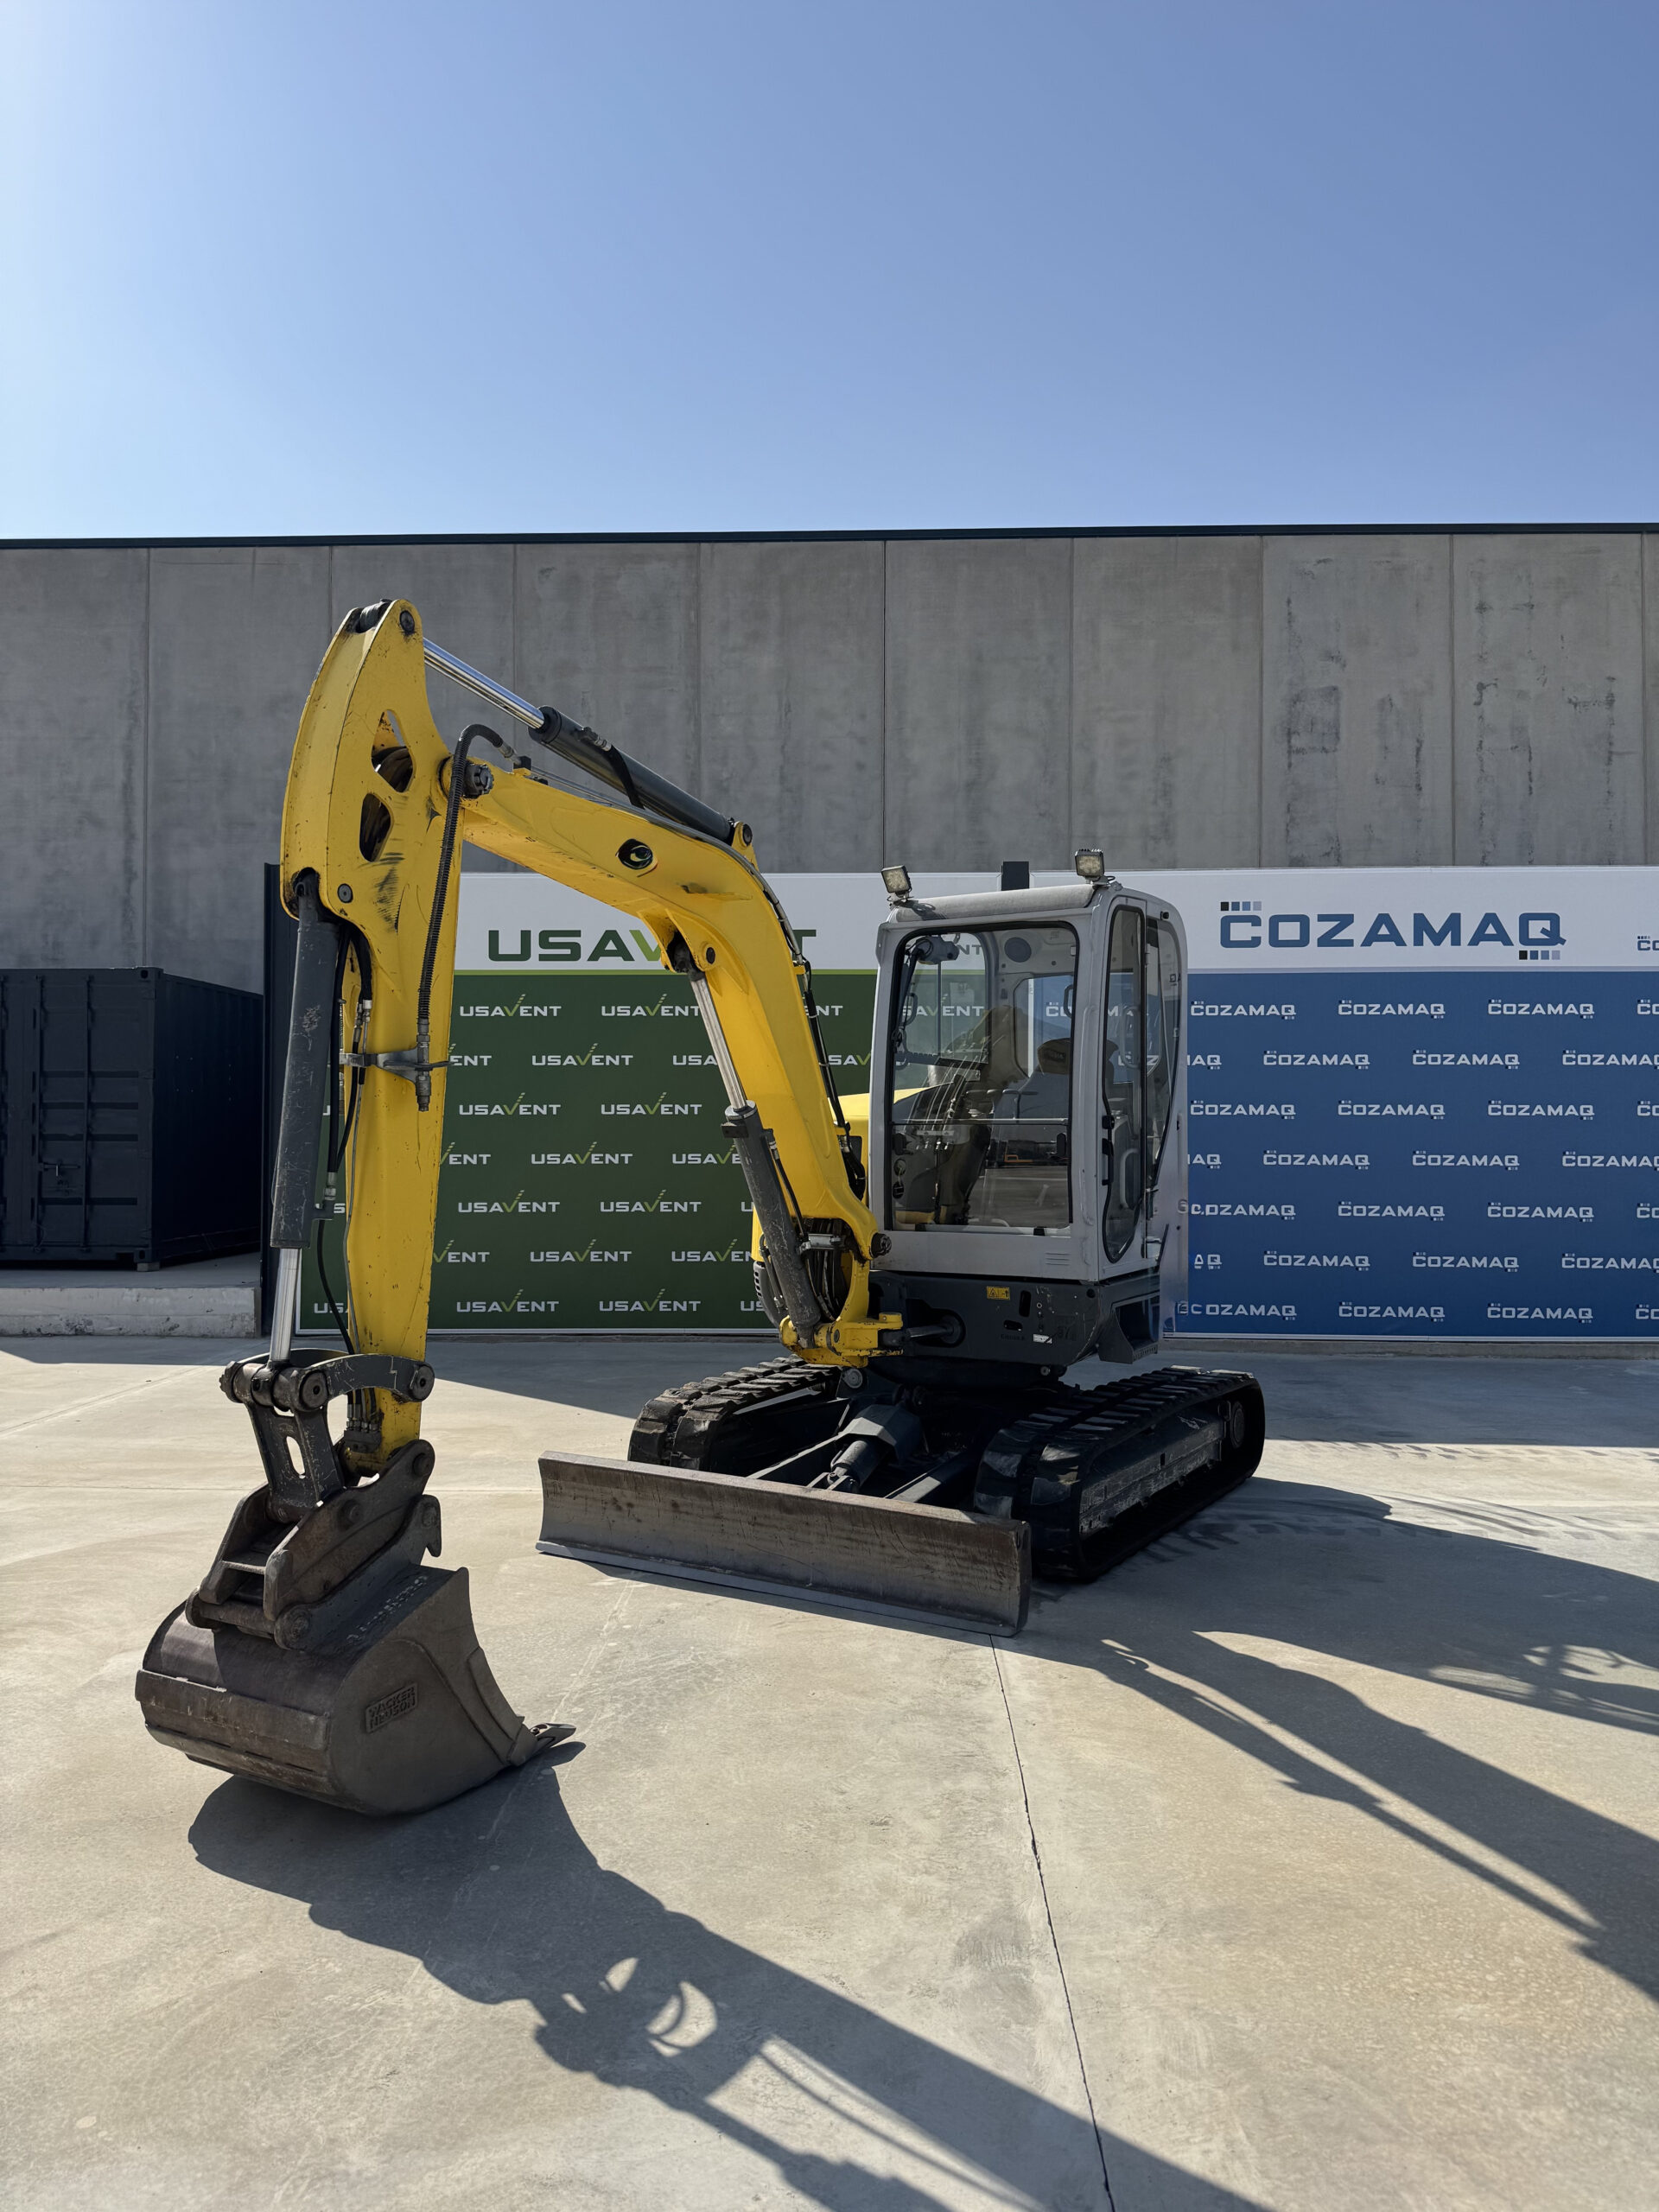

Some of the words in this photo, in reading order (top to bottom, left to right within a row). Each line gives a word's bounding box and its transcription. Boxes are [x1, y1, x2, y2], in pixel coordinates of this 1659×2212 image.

[1220, 912, 1567, 948] COZAMAQ
[1190, 1004, 1297, 1016] COZAMAQ
[1338, 1003, 1446, 1015] COZAMAQ
[1487, 1003, 1595, 1015] COZAMAQ
[1263, 1054, 1370, 1065] COZAMAQ
[1412, 1053, 1520, 1065] COZAMAQ
[1190, 1103, 1296, 1116] COZAMAQ
[1338, 1104, 1446, 1116] COZAMAQ
[1487, 1104, 1595, 1116] COZAMAQ
[1262, 1154, 1370, 1166] COZAMAQ
[1412, 1154, 1520, 1166] COZAMAQ
[1338, 1205, 1446, 1217] COZAMAQ
[1487, 1206, 1594, 1218] COZAMAQ
[1263, 1255, 1370, 1267] COZAMAQ
[1412, 1255, 1520, 1268] COZAMAQ
[1338, 1306, 1446, 1318] COZAMAQ
[1487, 1307, 1593, 1319] COZAMAQ
